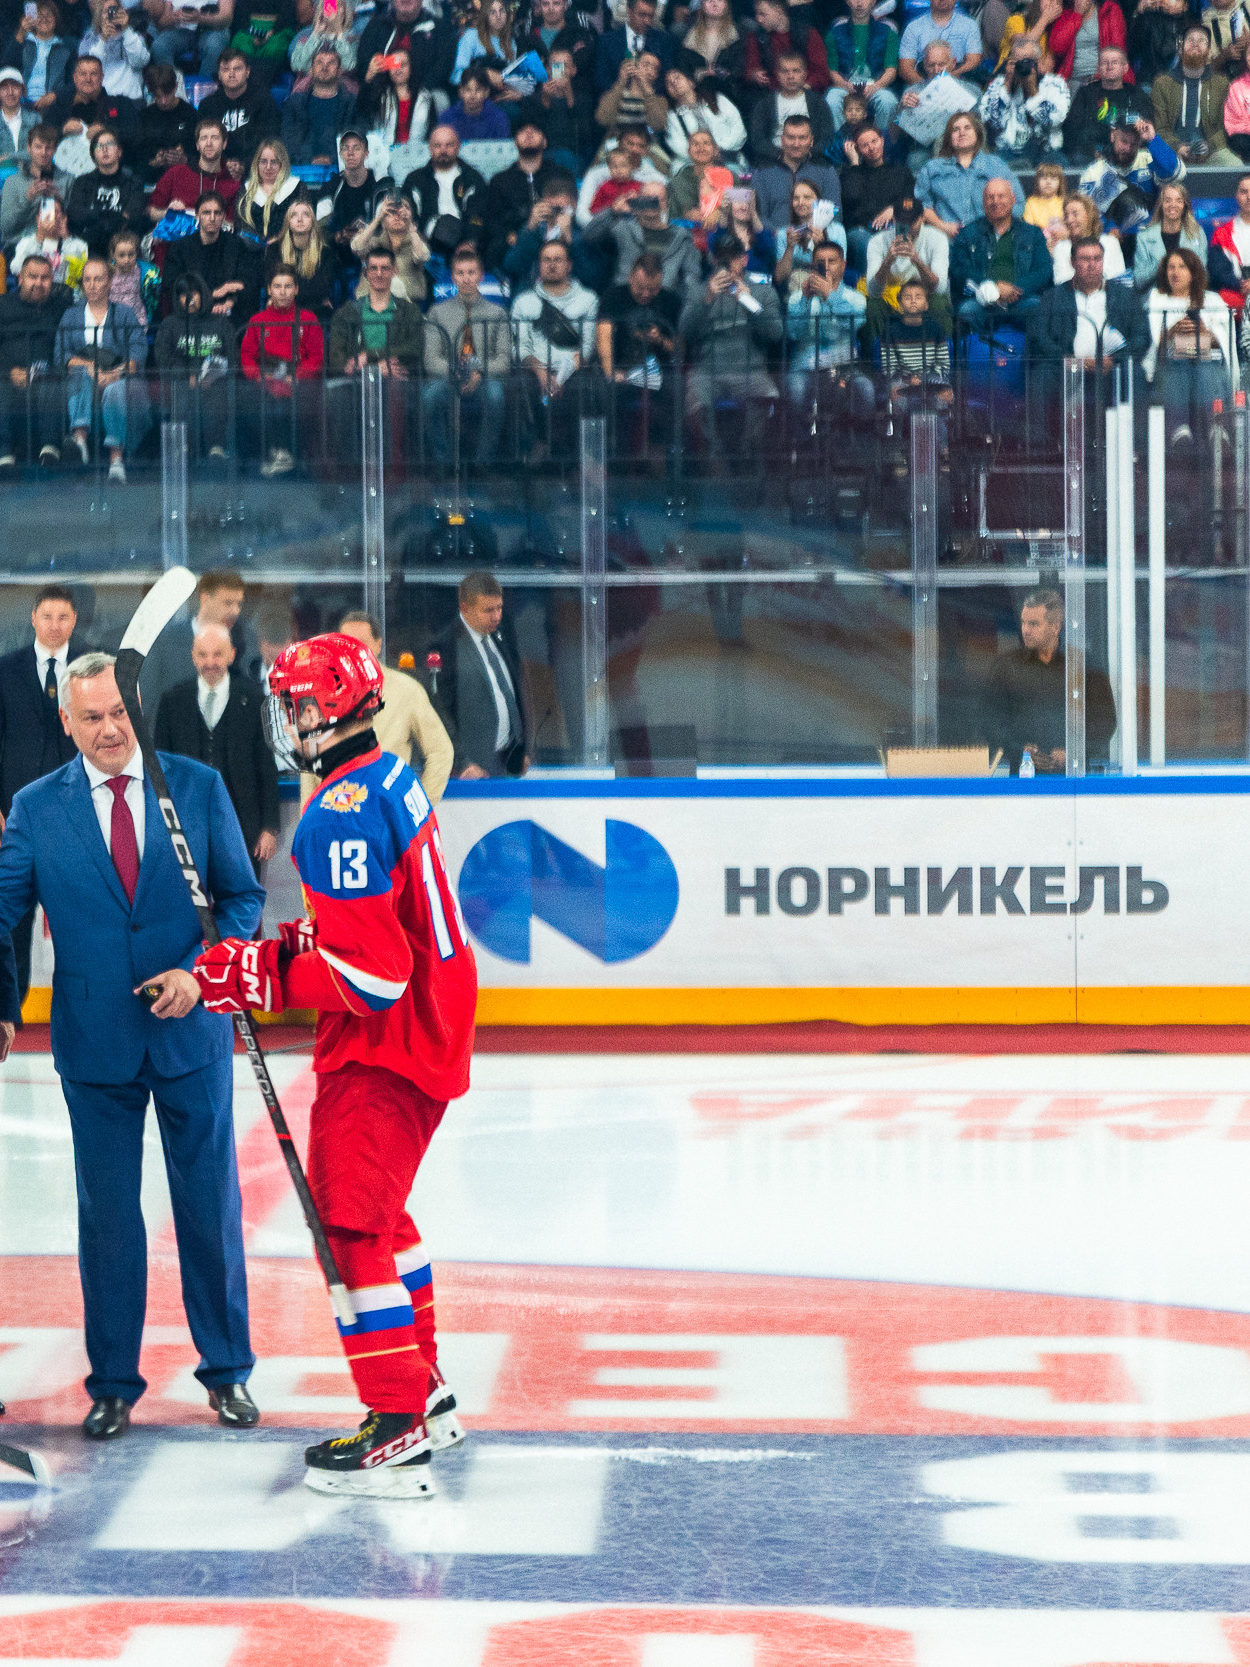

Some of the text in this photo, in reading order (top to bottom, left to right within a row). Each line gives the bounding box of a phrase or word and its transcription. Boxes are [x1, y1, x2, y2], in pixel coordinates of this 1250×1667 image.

[158, 797, 209, 908] CCM
[328, 839, 368, 890] 13
[723, 866, 1171, 918] НОРНИКЕЛЬ
[361, 1425, 425, 1469] CCM
